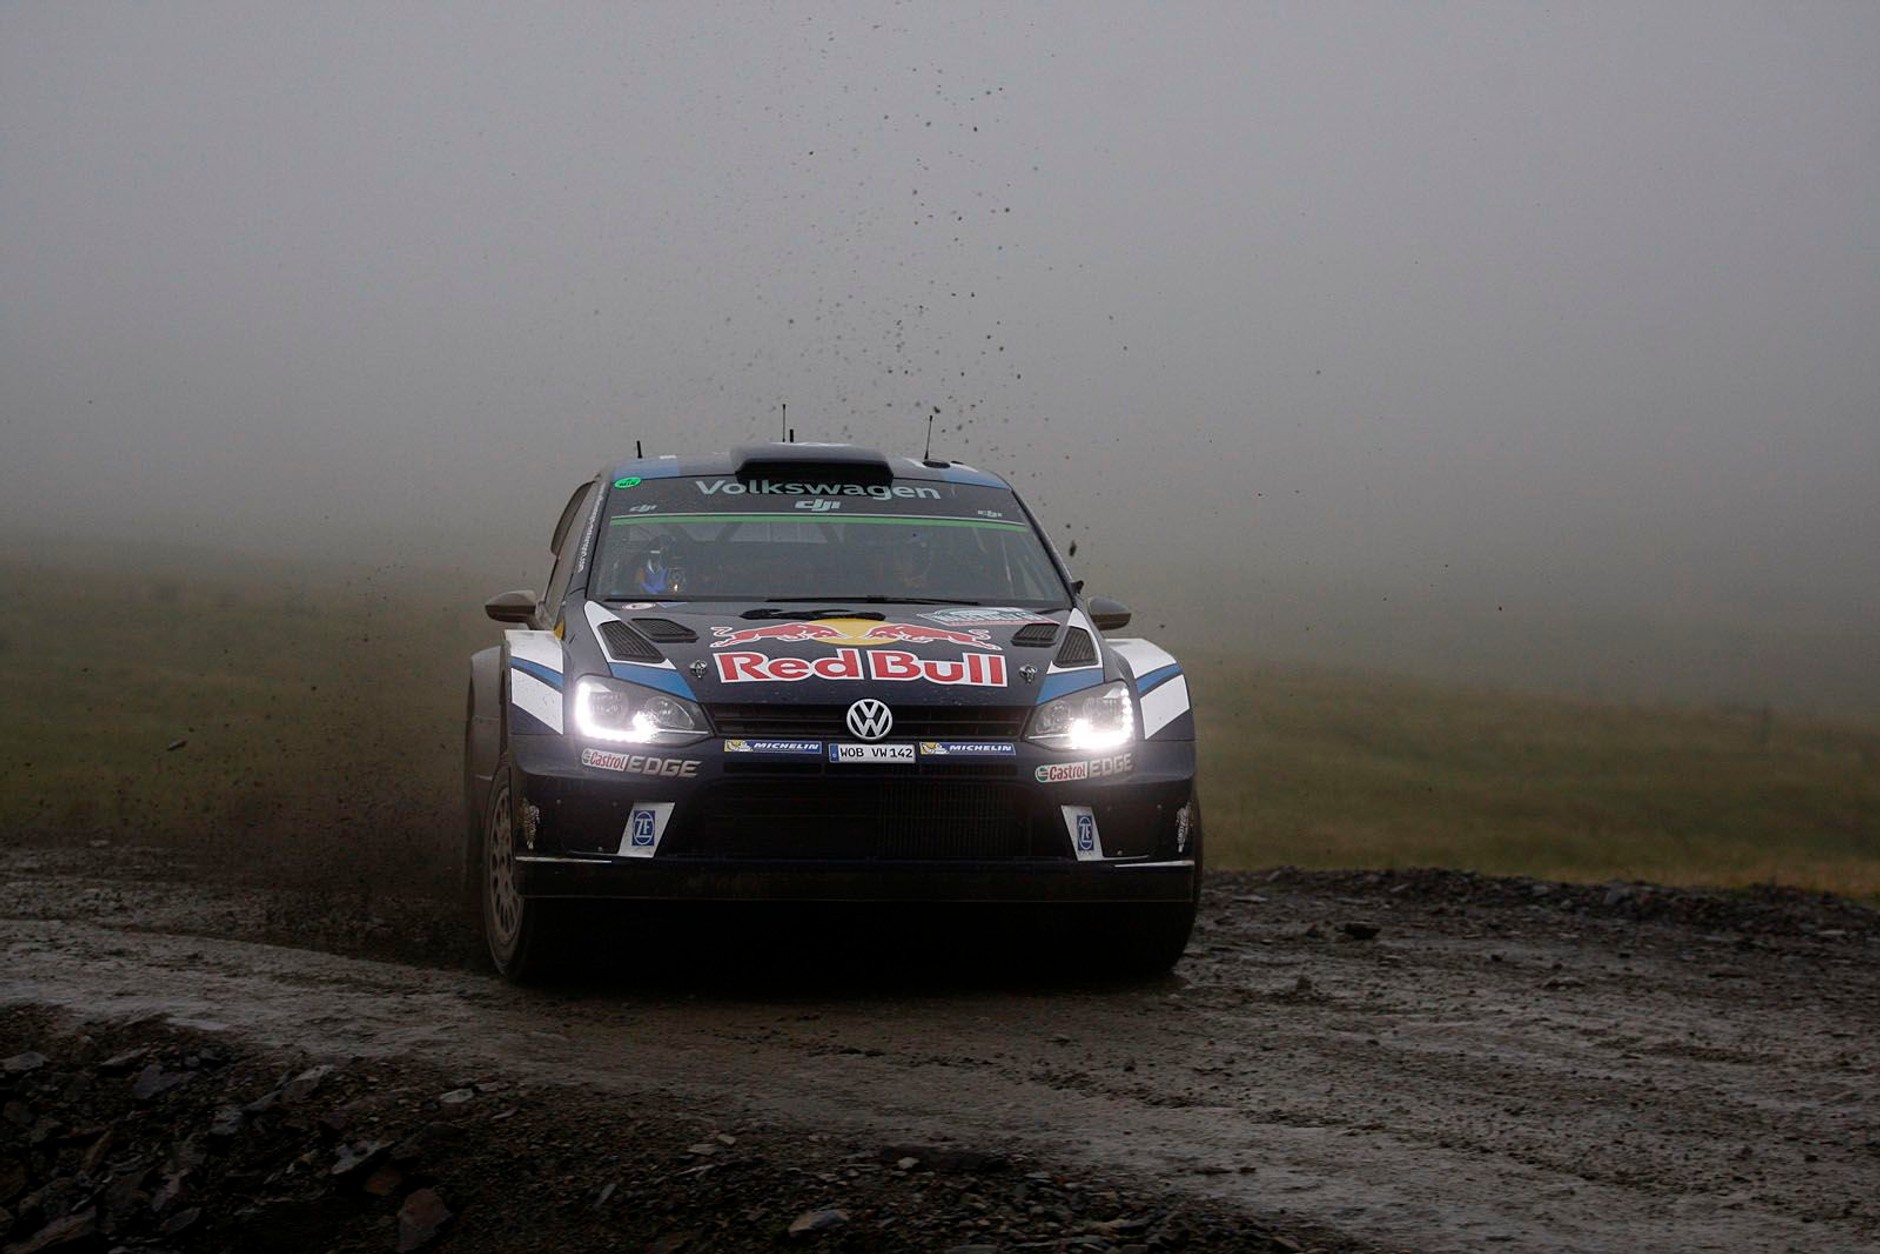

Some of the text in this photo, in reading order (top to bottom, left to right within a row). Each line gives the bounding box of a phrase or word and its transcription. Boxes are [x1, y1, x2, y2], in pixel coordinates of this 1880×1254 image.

[695, 479, 941, 500] Volkswagen
[713, 649, 1008, 687] Red Bull
[753, 742, 819, 750] MICHELIN
[840, 747, 913, 759] WOB VW 142
[949, 744, 1012, 752] MICHELIN
[590, 751, 702, 778] Castrol EDGE
[1050, 753, 1134, 781] Castrol EDGE
[635, 818, 652, 838] ZF
[1079, 823, 1092, 843] ZF
